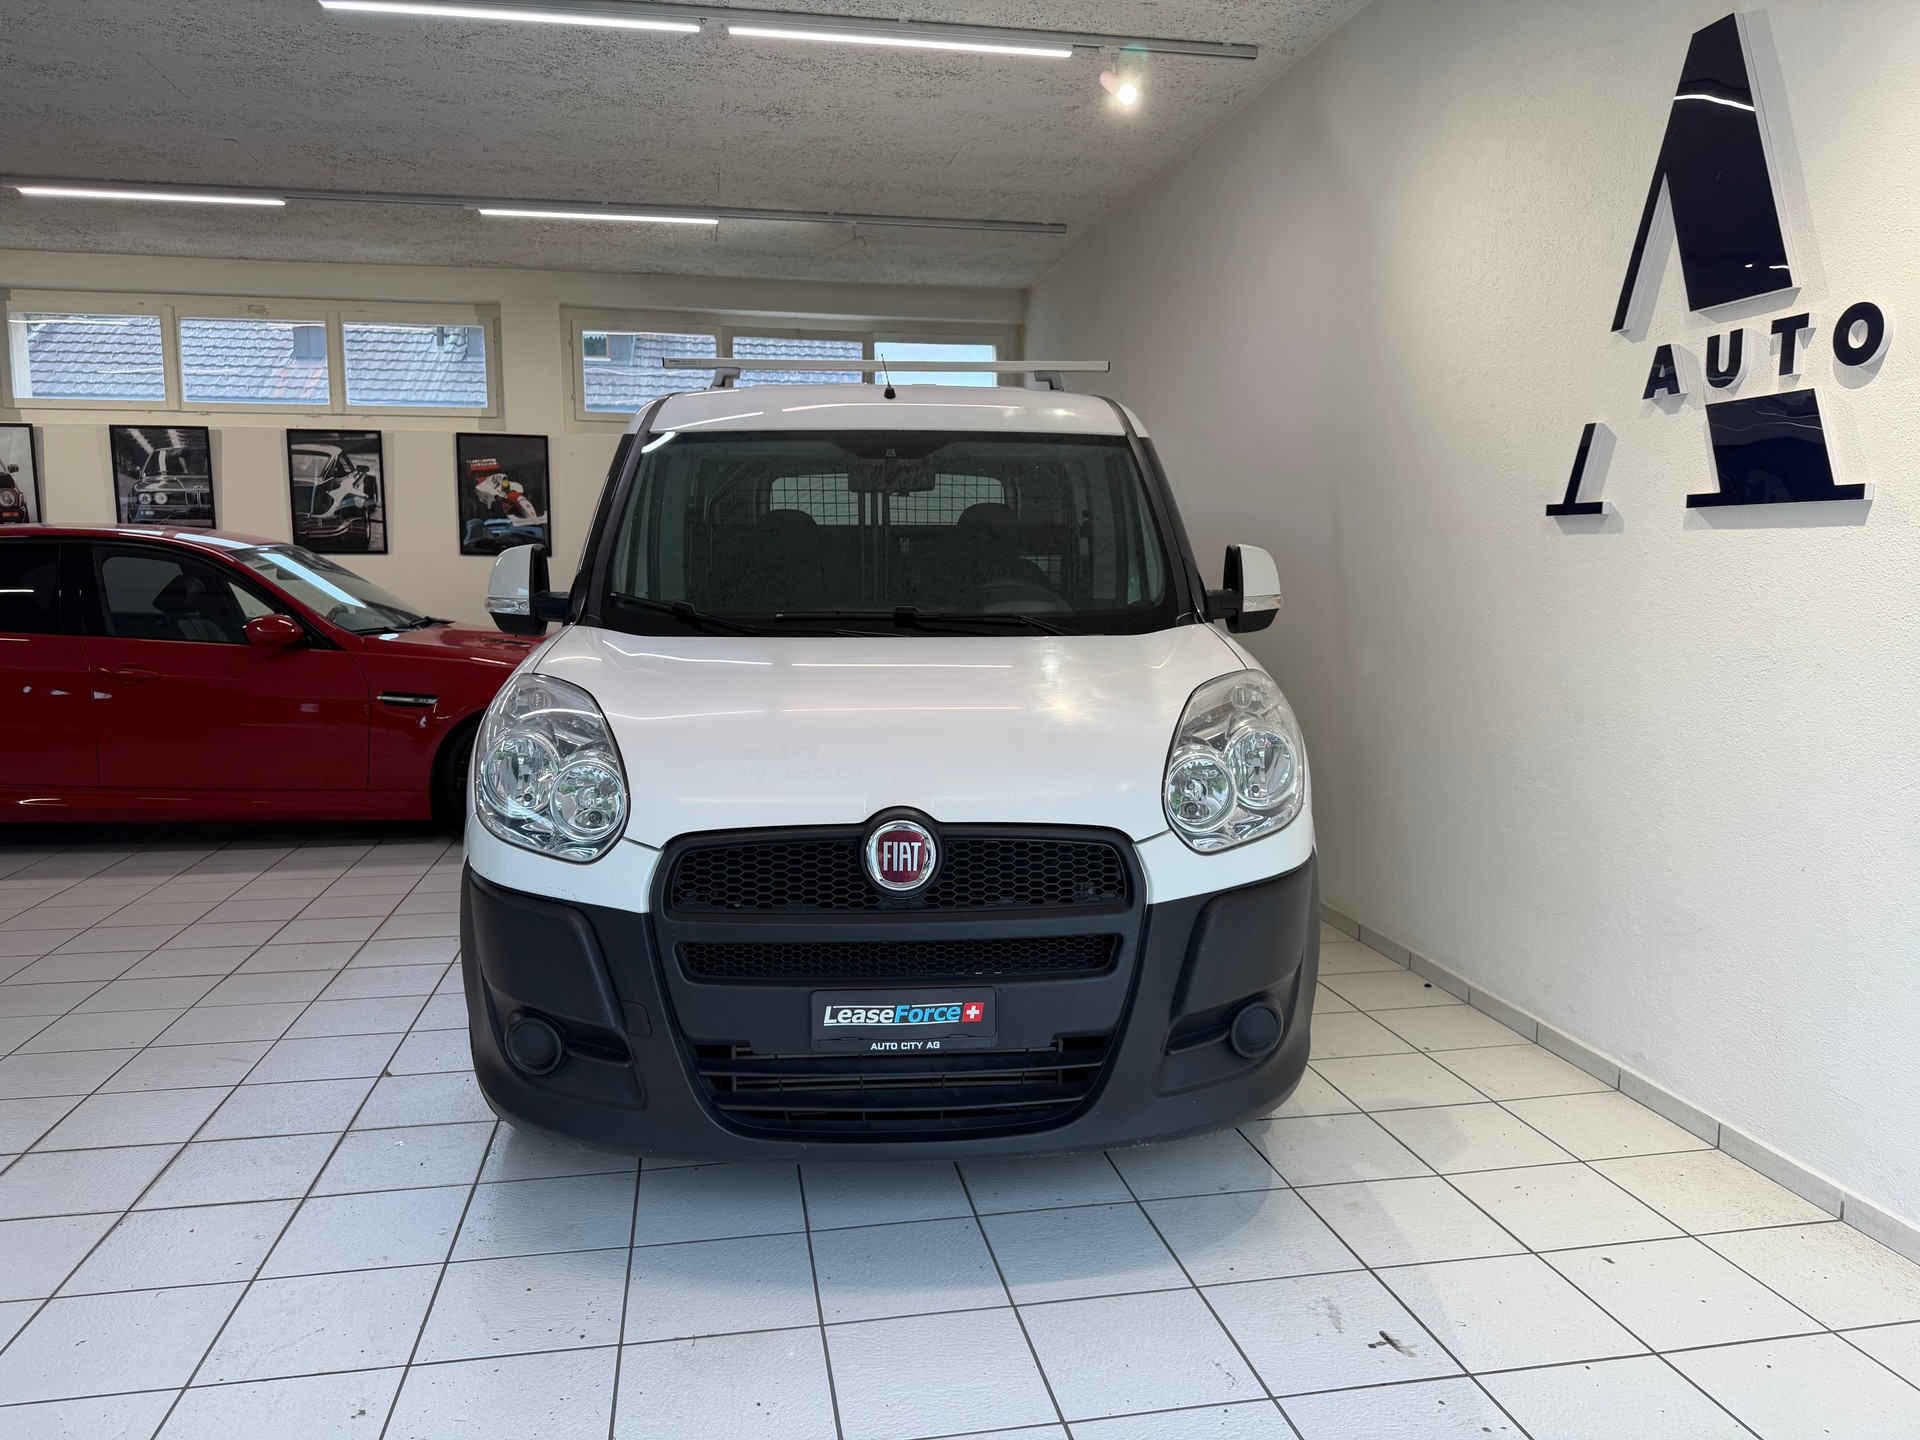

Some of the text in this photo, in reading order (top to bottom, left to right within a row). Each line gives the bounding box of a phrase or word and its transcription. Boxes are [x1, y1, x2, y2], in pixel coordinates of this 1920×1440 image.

[1642, 302, 1888, 400] AUTO
[883, 842, 921, 871] FIAT
[824, 1004, 961, 1024] LeaseForce
[871, 1041, 940, 1050] AUTO CITY AG
